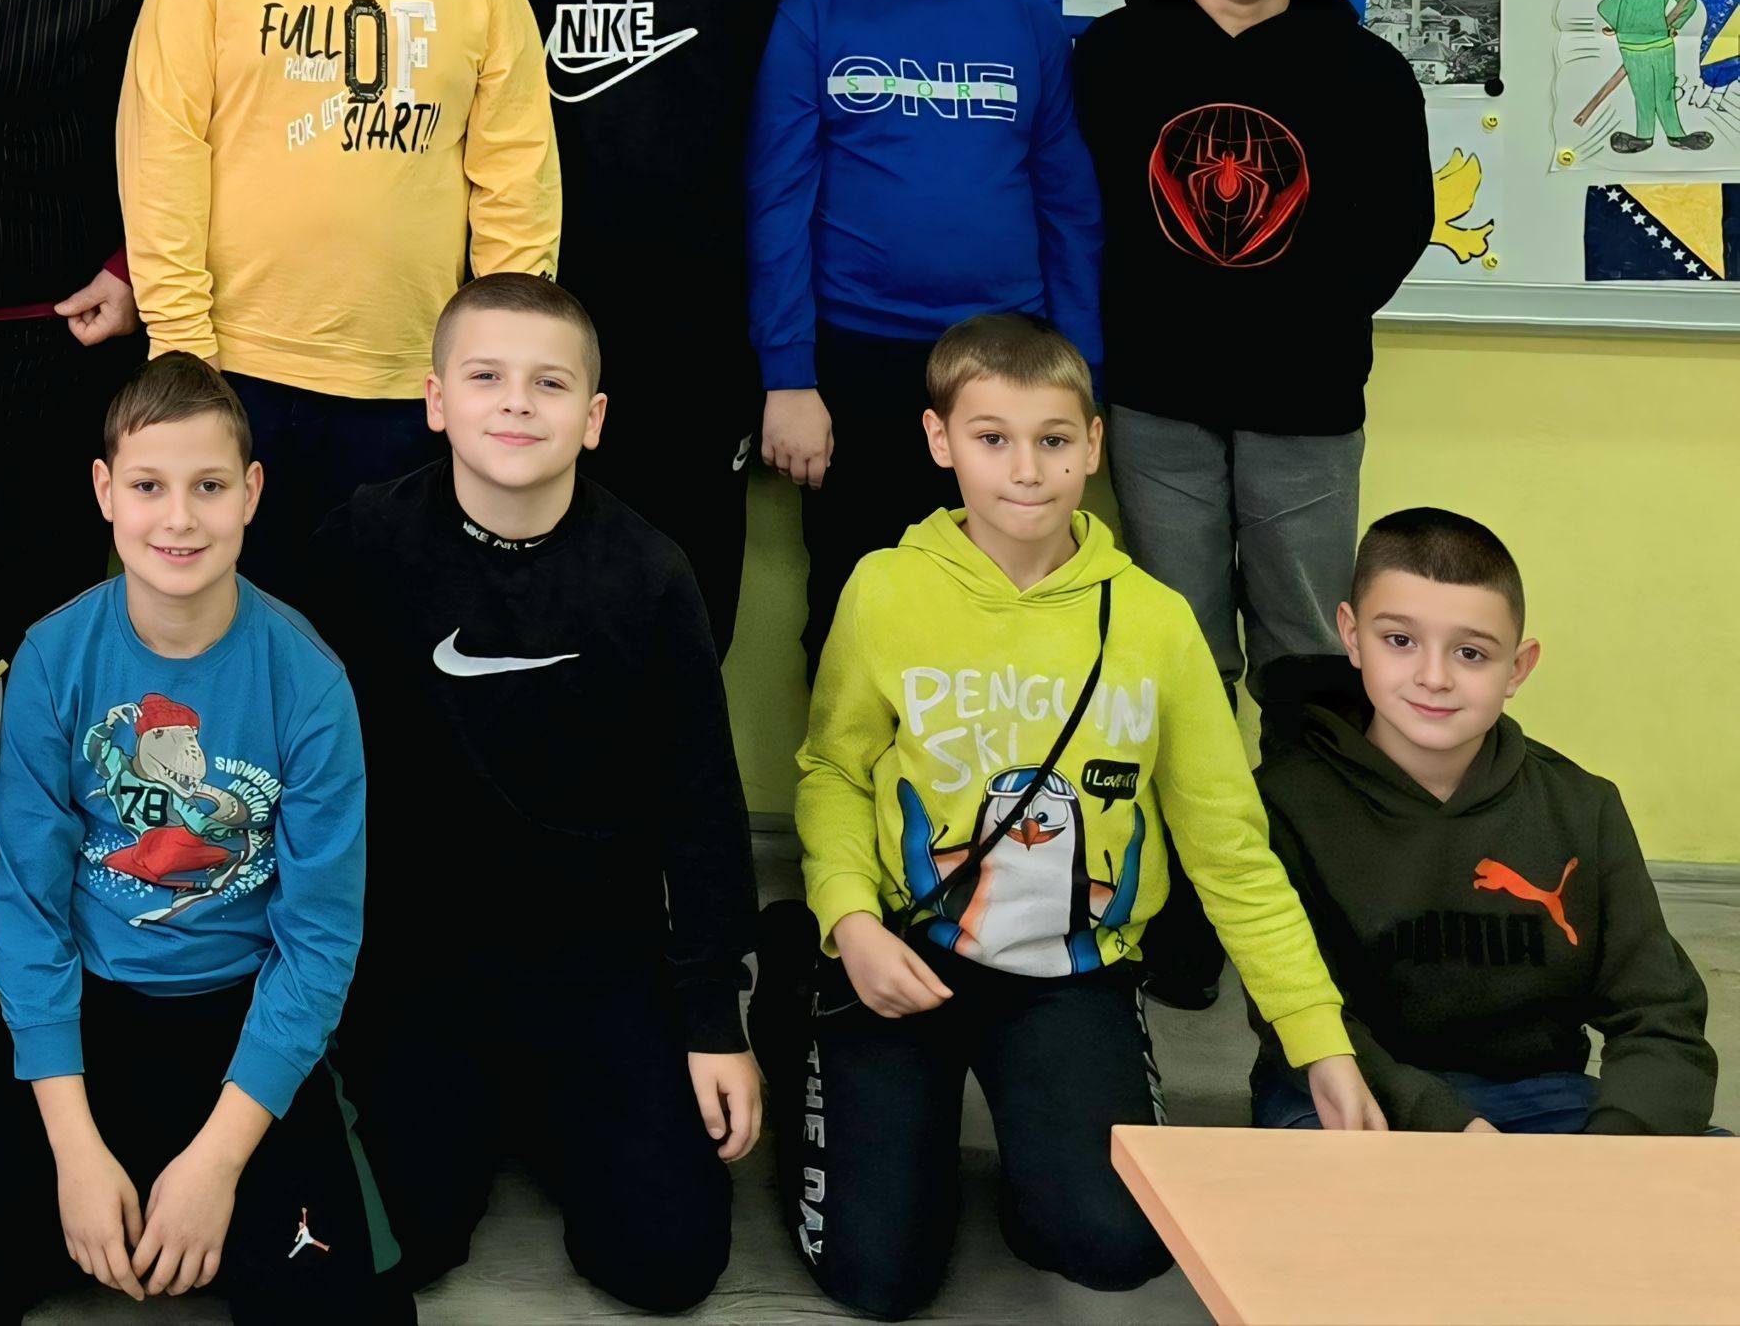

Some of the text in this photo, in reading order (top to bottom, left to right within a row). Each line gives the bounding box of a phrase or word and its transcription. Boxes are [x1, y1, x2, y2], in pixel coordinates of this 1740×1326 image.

[259, 2, 342, 60] FULL
[555, 1, 655, 58] NIKE
[830, 55, 1017, 123] ONE
[845, 76, 1006, 100] SPORT
[922, 722, 1018, 793] SKI
[120, 785, 169, 827] 78
